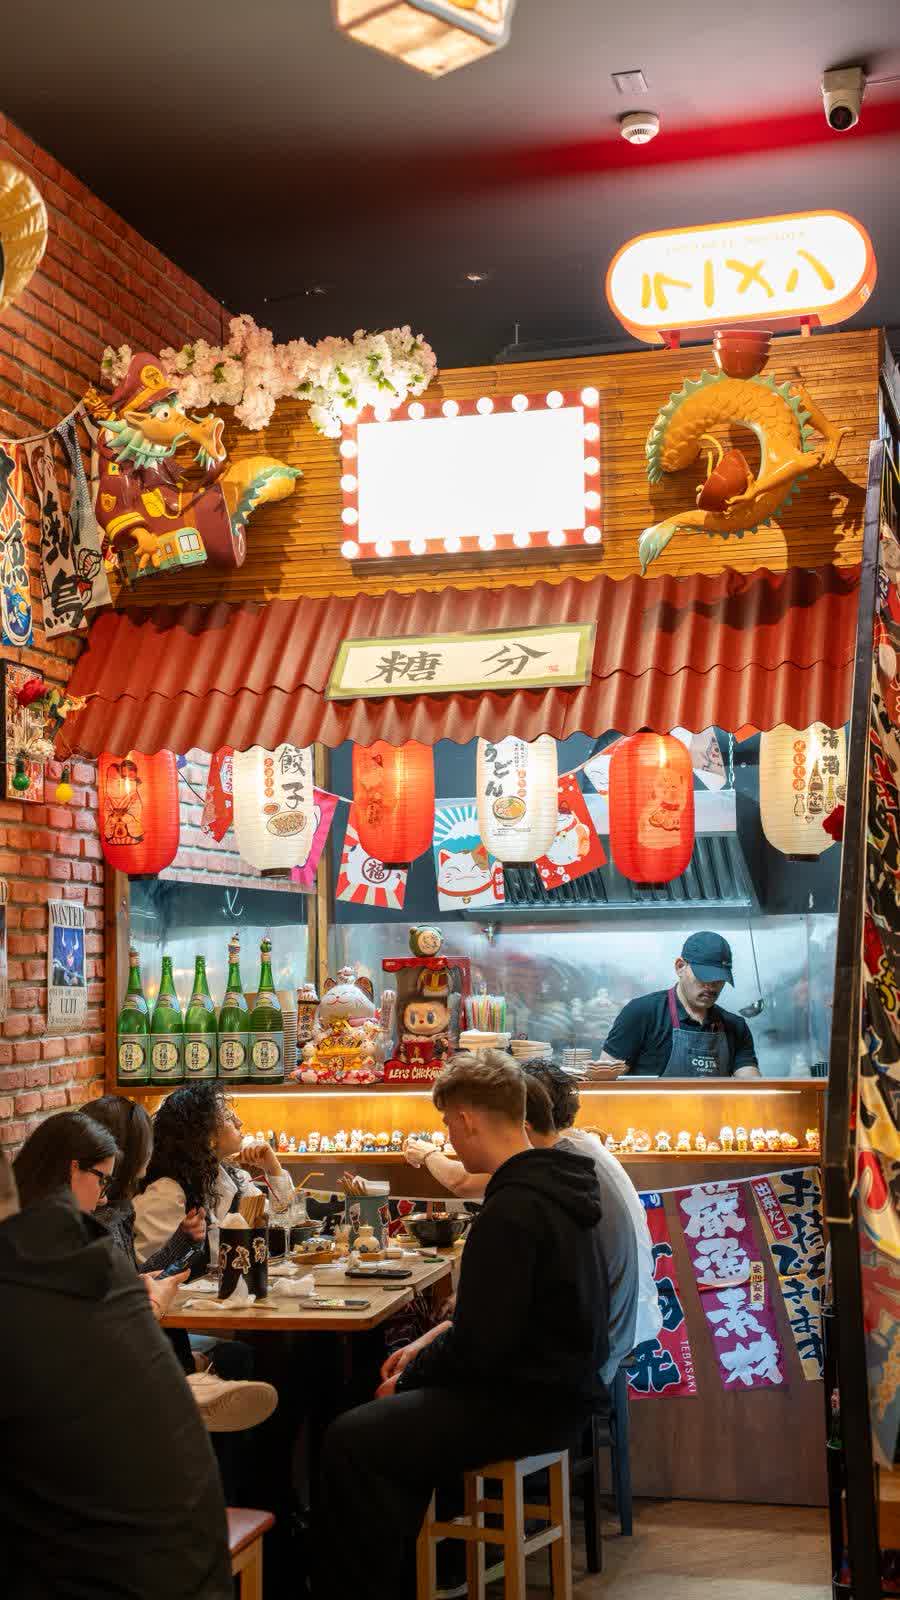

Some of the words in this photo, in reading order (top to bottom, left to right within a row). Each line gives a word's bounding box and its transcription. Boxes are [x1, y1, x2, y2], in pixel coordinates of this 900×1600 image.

[365, 643, 551, 683] 糖分
[484, 743, 513, 798] うどん
[821, 728, 840, 776] 清酒
[279, 746, 306, 810] 餃子
[50, 903, 85, 928] WANTED
[692, 1058, 717, 1069] COSTA
[754, 1182, 789, 1236] 出来たて
[680, 1340, 697, 1393] TEBASAKI
